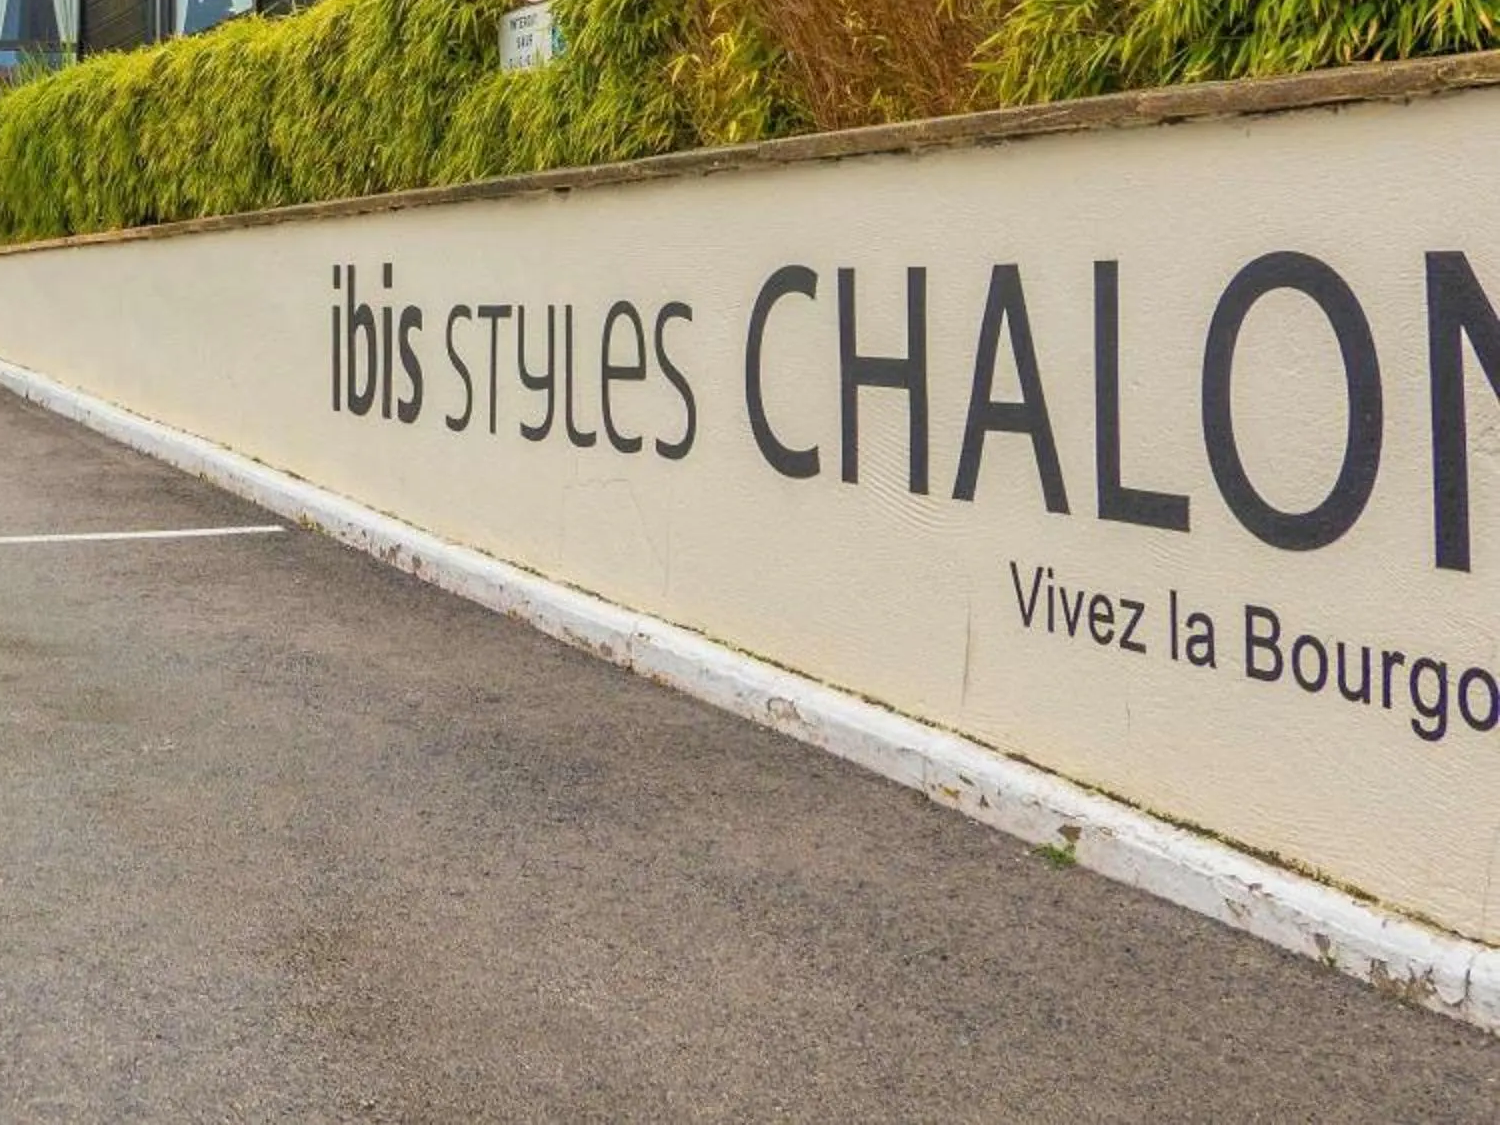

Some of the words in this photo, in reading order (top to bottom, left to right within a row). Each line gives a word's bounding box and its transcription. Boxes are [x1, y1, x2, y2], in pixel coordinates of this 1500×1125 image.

[333, 262, 423, 424] ibis
[1009, 560, 1148, 655] Vivez
[1169, 588, 1218, 670] la
[1244, 603, 1500, 743] Bourgo
